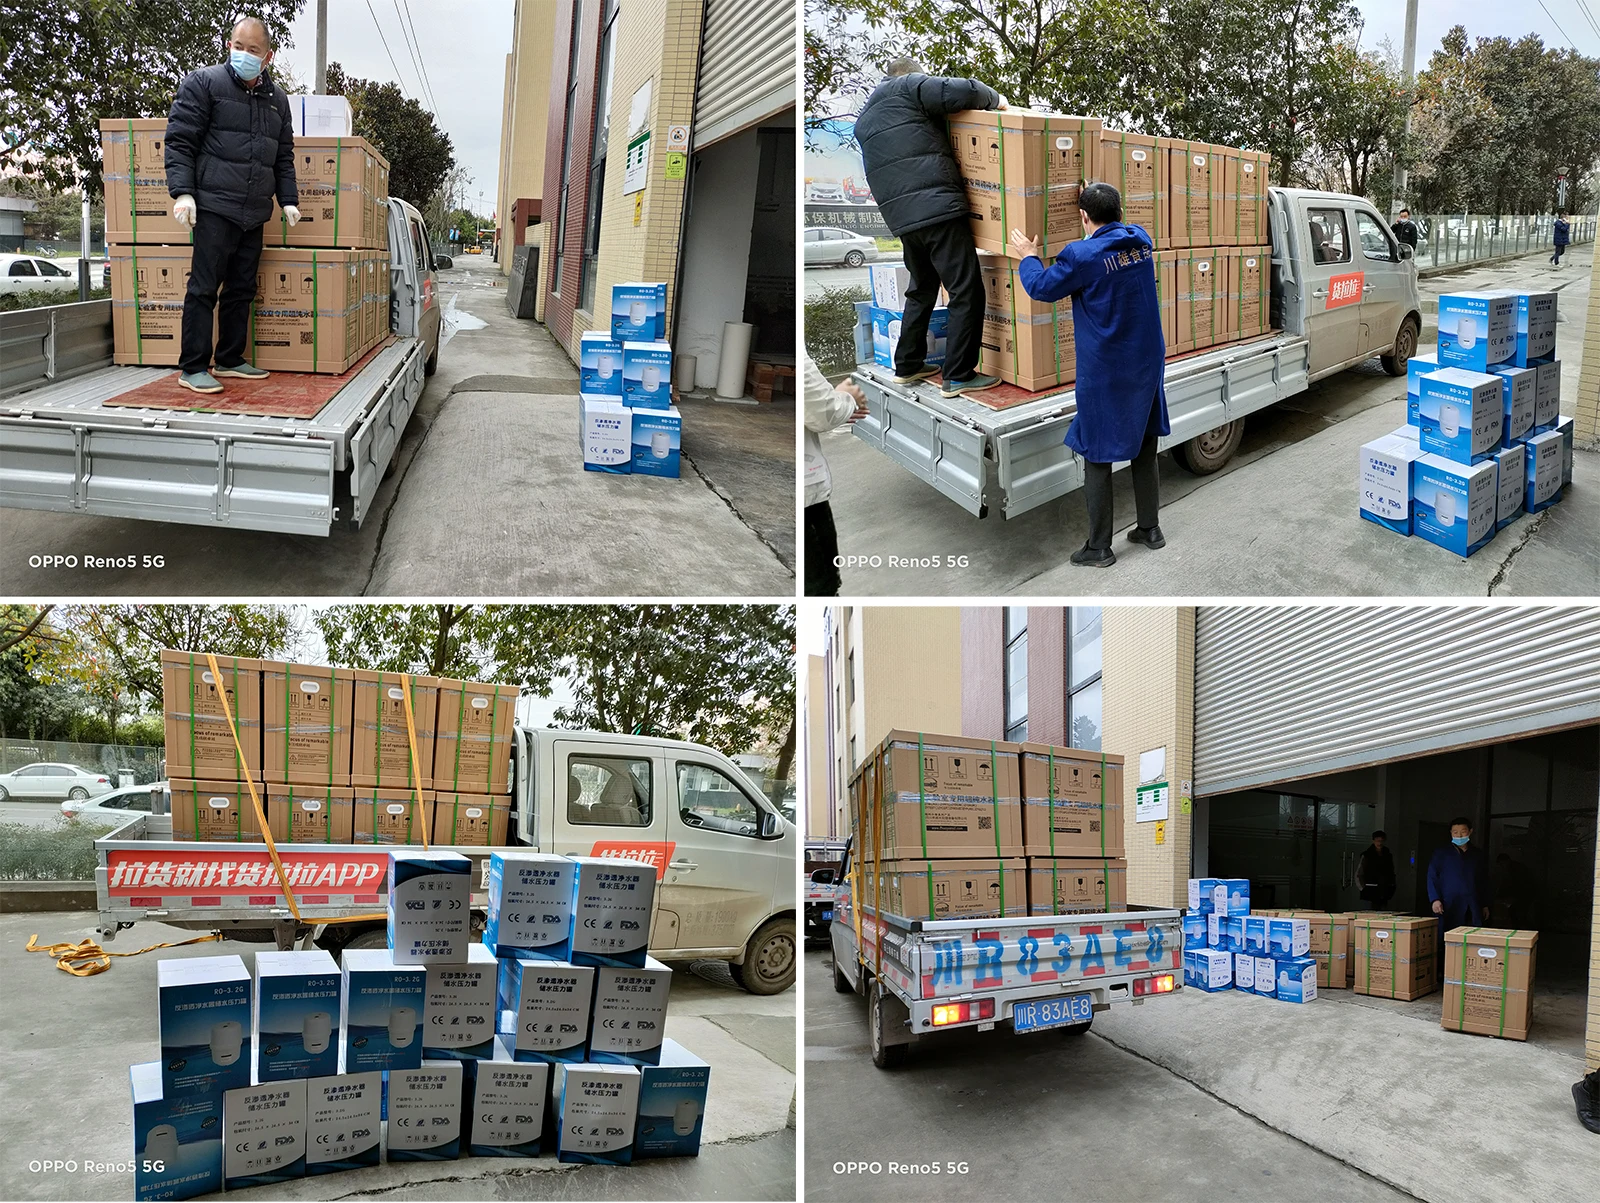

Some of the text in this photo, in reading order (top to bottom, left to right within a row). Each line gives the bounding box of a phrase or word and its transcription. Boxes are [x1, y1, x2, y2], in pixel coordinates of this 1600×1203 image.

[109, 861, 380, 888] 拉货就找货拉拉APP
[518, 869, 560, 878] 反渗透净水器
[596, 873, 640, 883] 反渗透净水器
[521, 877, 556, 886] 储水压力罐
[599, 882, 635, 891] 储水压力罐
[508, 913, 520, 923] CE
[584, 919, 596, 928] CE
[536, 977, 577, 985] 反渗透净水器
[614, 977, 656, 985] 反渗透净水器
[539, 985, 573, 993] 储水压力罐
[617, 985, 652, 993] 储水压力罐
[431, 1016, 444, 1025] CE
[602, 1019, 615, 1029] CE
[526, 1023, 538, 1033] CE
[406, 1075, 447, 1083] 反渗透净水器
[492, 1072, 533, 1080] 反渗透净水器
[323, 1083, 365, 1095] 反渗透净水器
[581, 1082, 623, 1090] 反渗透净水器
[326, 1092, 362, 1102] 储水压力罐
[584, 1089, 619, 1097] 储水压力罐
[244, 1092, 290, 1104] 反渗透净水器
[248, 1100, 286, 1112] 储水压力罐
[397, 1118, 409, 1127] CE
[482, 1114, 494, 1123] CE
[571, 1126, 583, 1135] CE
[316, 1134, 329, 1144] CE
[236, 1142, 250, 1153] CE
